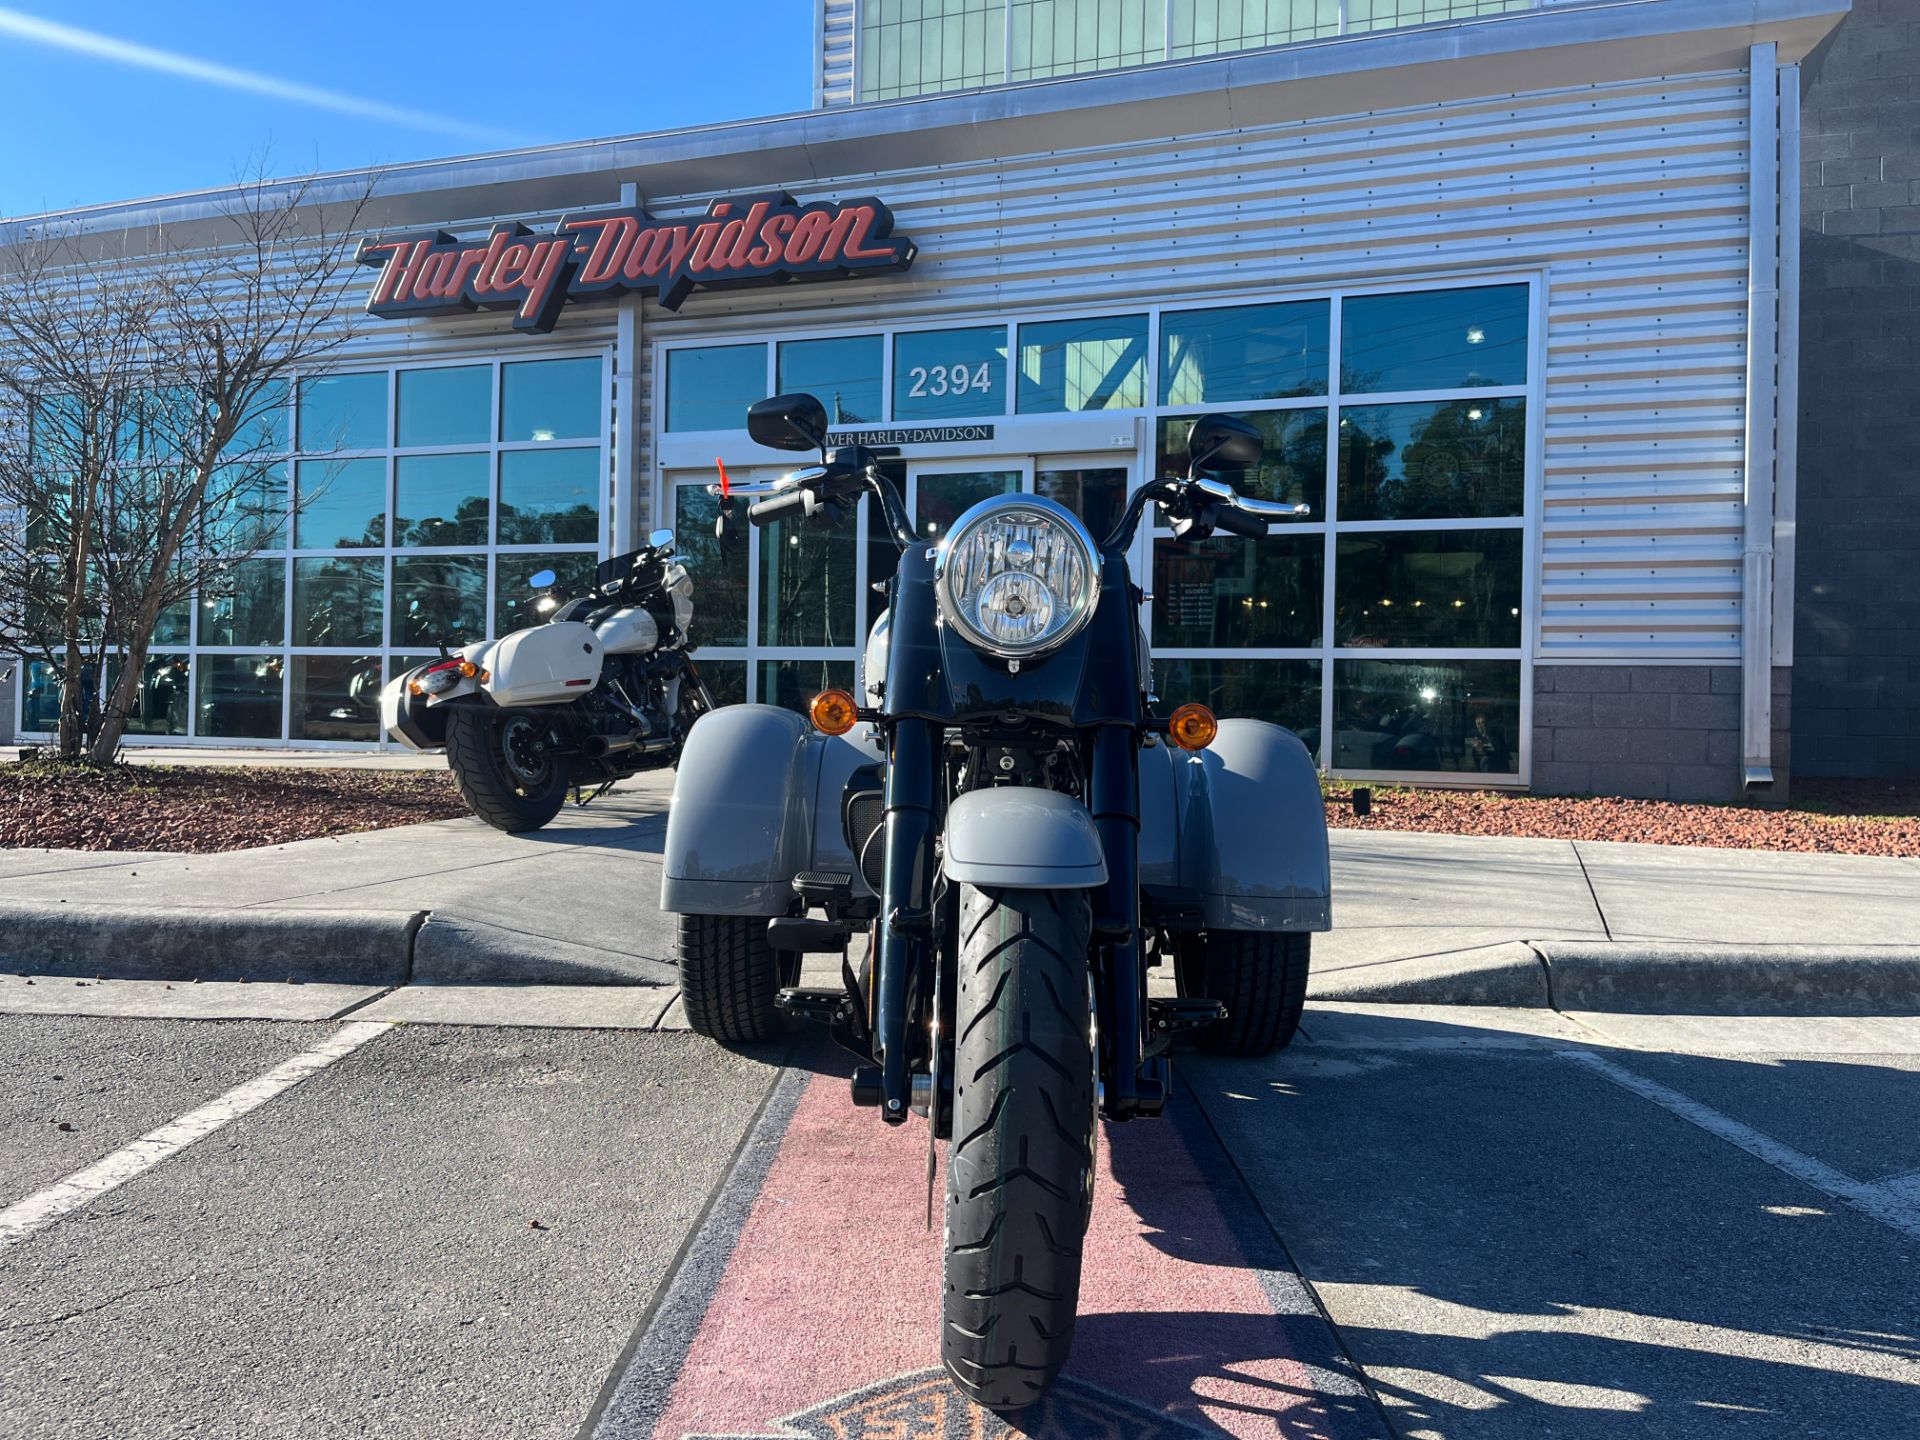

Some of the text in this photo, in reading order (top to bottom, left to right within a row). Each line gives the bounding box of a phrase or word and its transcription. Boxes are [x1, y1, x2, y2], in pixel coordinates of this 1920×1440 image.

[362, 201, 896, 319] Harley-Davidson
[908, 362, 992, 398] 2394
[822, 426, 988, 447] IVER HARLEY-DAVIDSON
